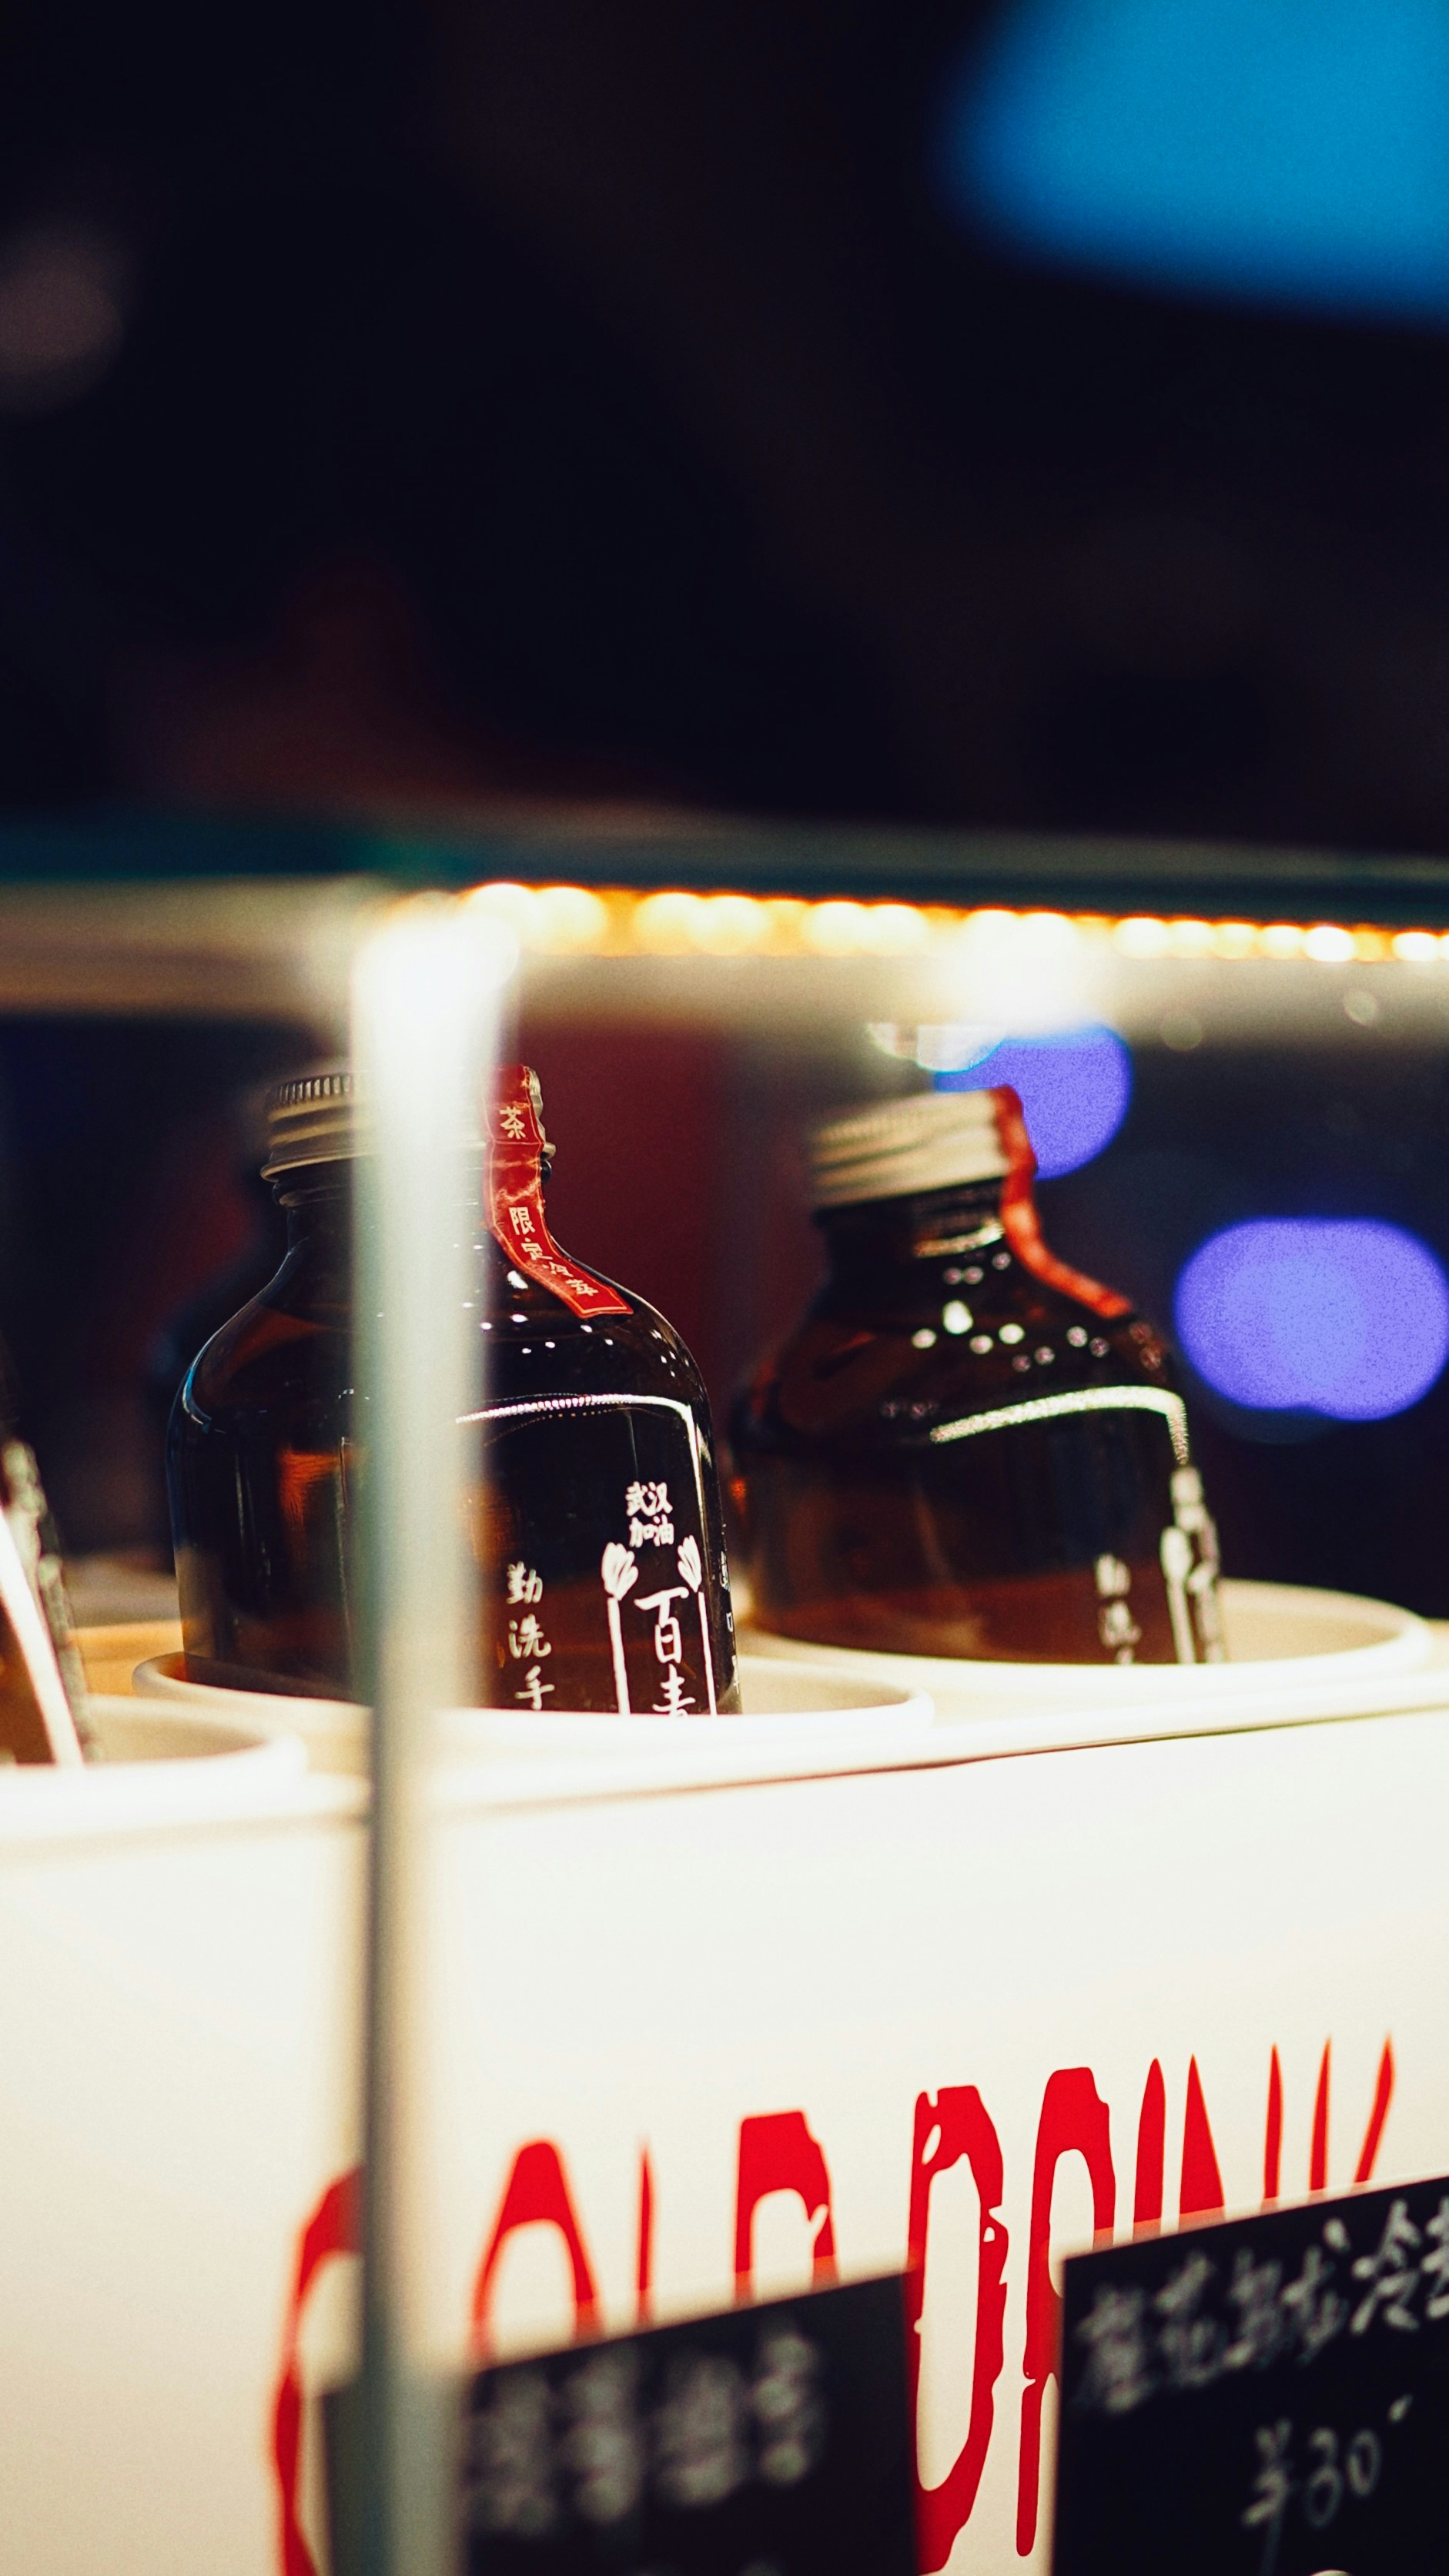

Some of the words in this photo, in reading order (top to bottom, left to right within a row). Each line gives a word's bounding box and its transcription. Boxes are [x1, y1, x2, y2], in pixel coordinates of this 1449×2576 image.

[500, 1106, 527, 1139] 茶
[625, 1480, 673, 1516] 武汉
[629, 1514, 674, 1547] 加油
[506, 1561, 554, 1710] 勤洗手
